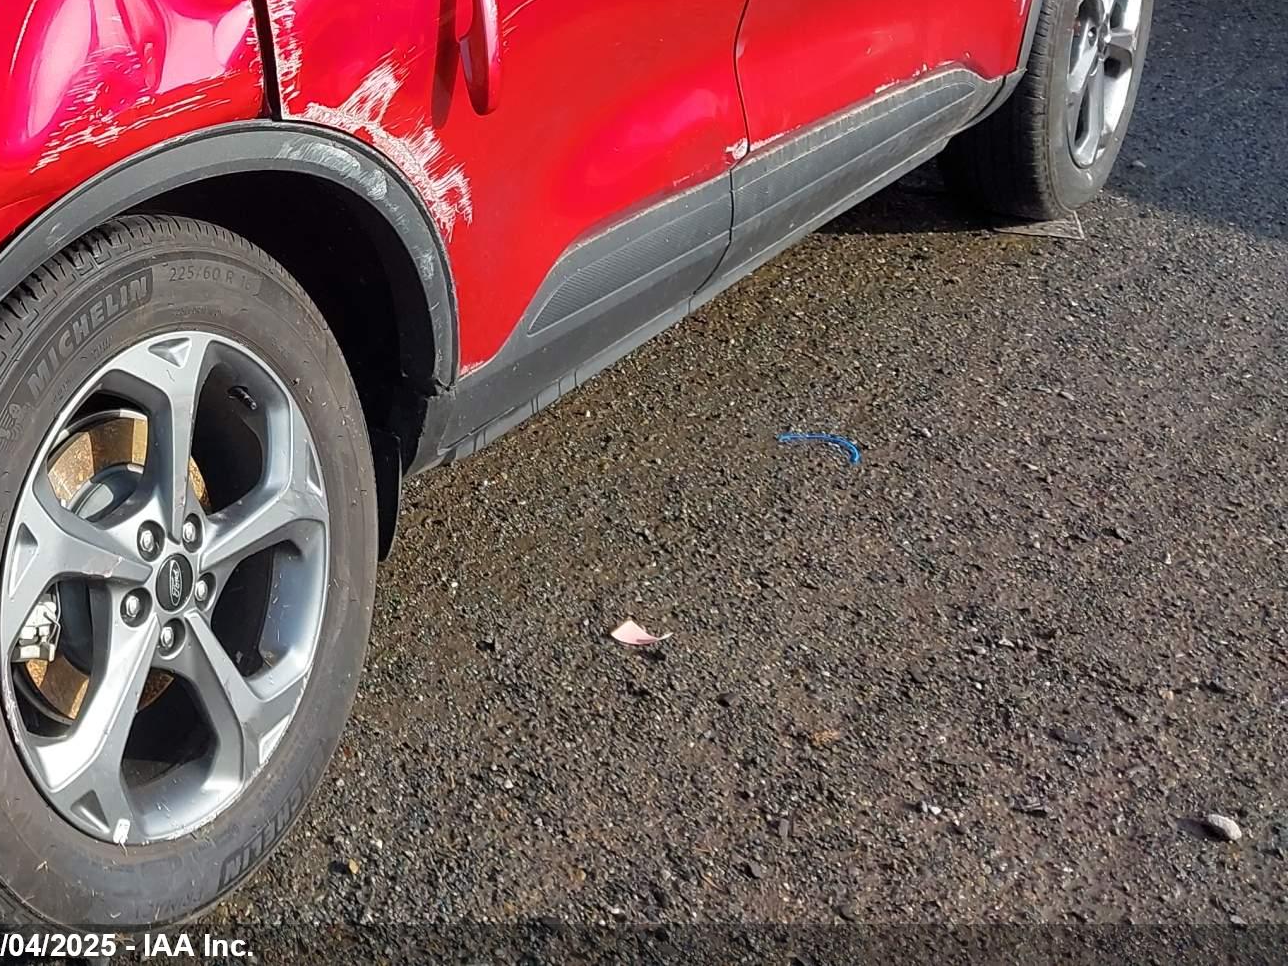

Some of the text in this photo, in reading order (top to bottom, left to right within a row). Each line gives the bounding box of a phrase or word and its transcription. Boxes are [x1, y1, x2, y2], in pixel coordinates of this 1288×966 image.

[168, 266, 221, 282] 225/60
[225, 269, 234, 285] R
[27, 275, 149, 398] MICHELIN
